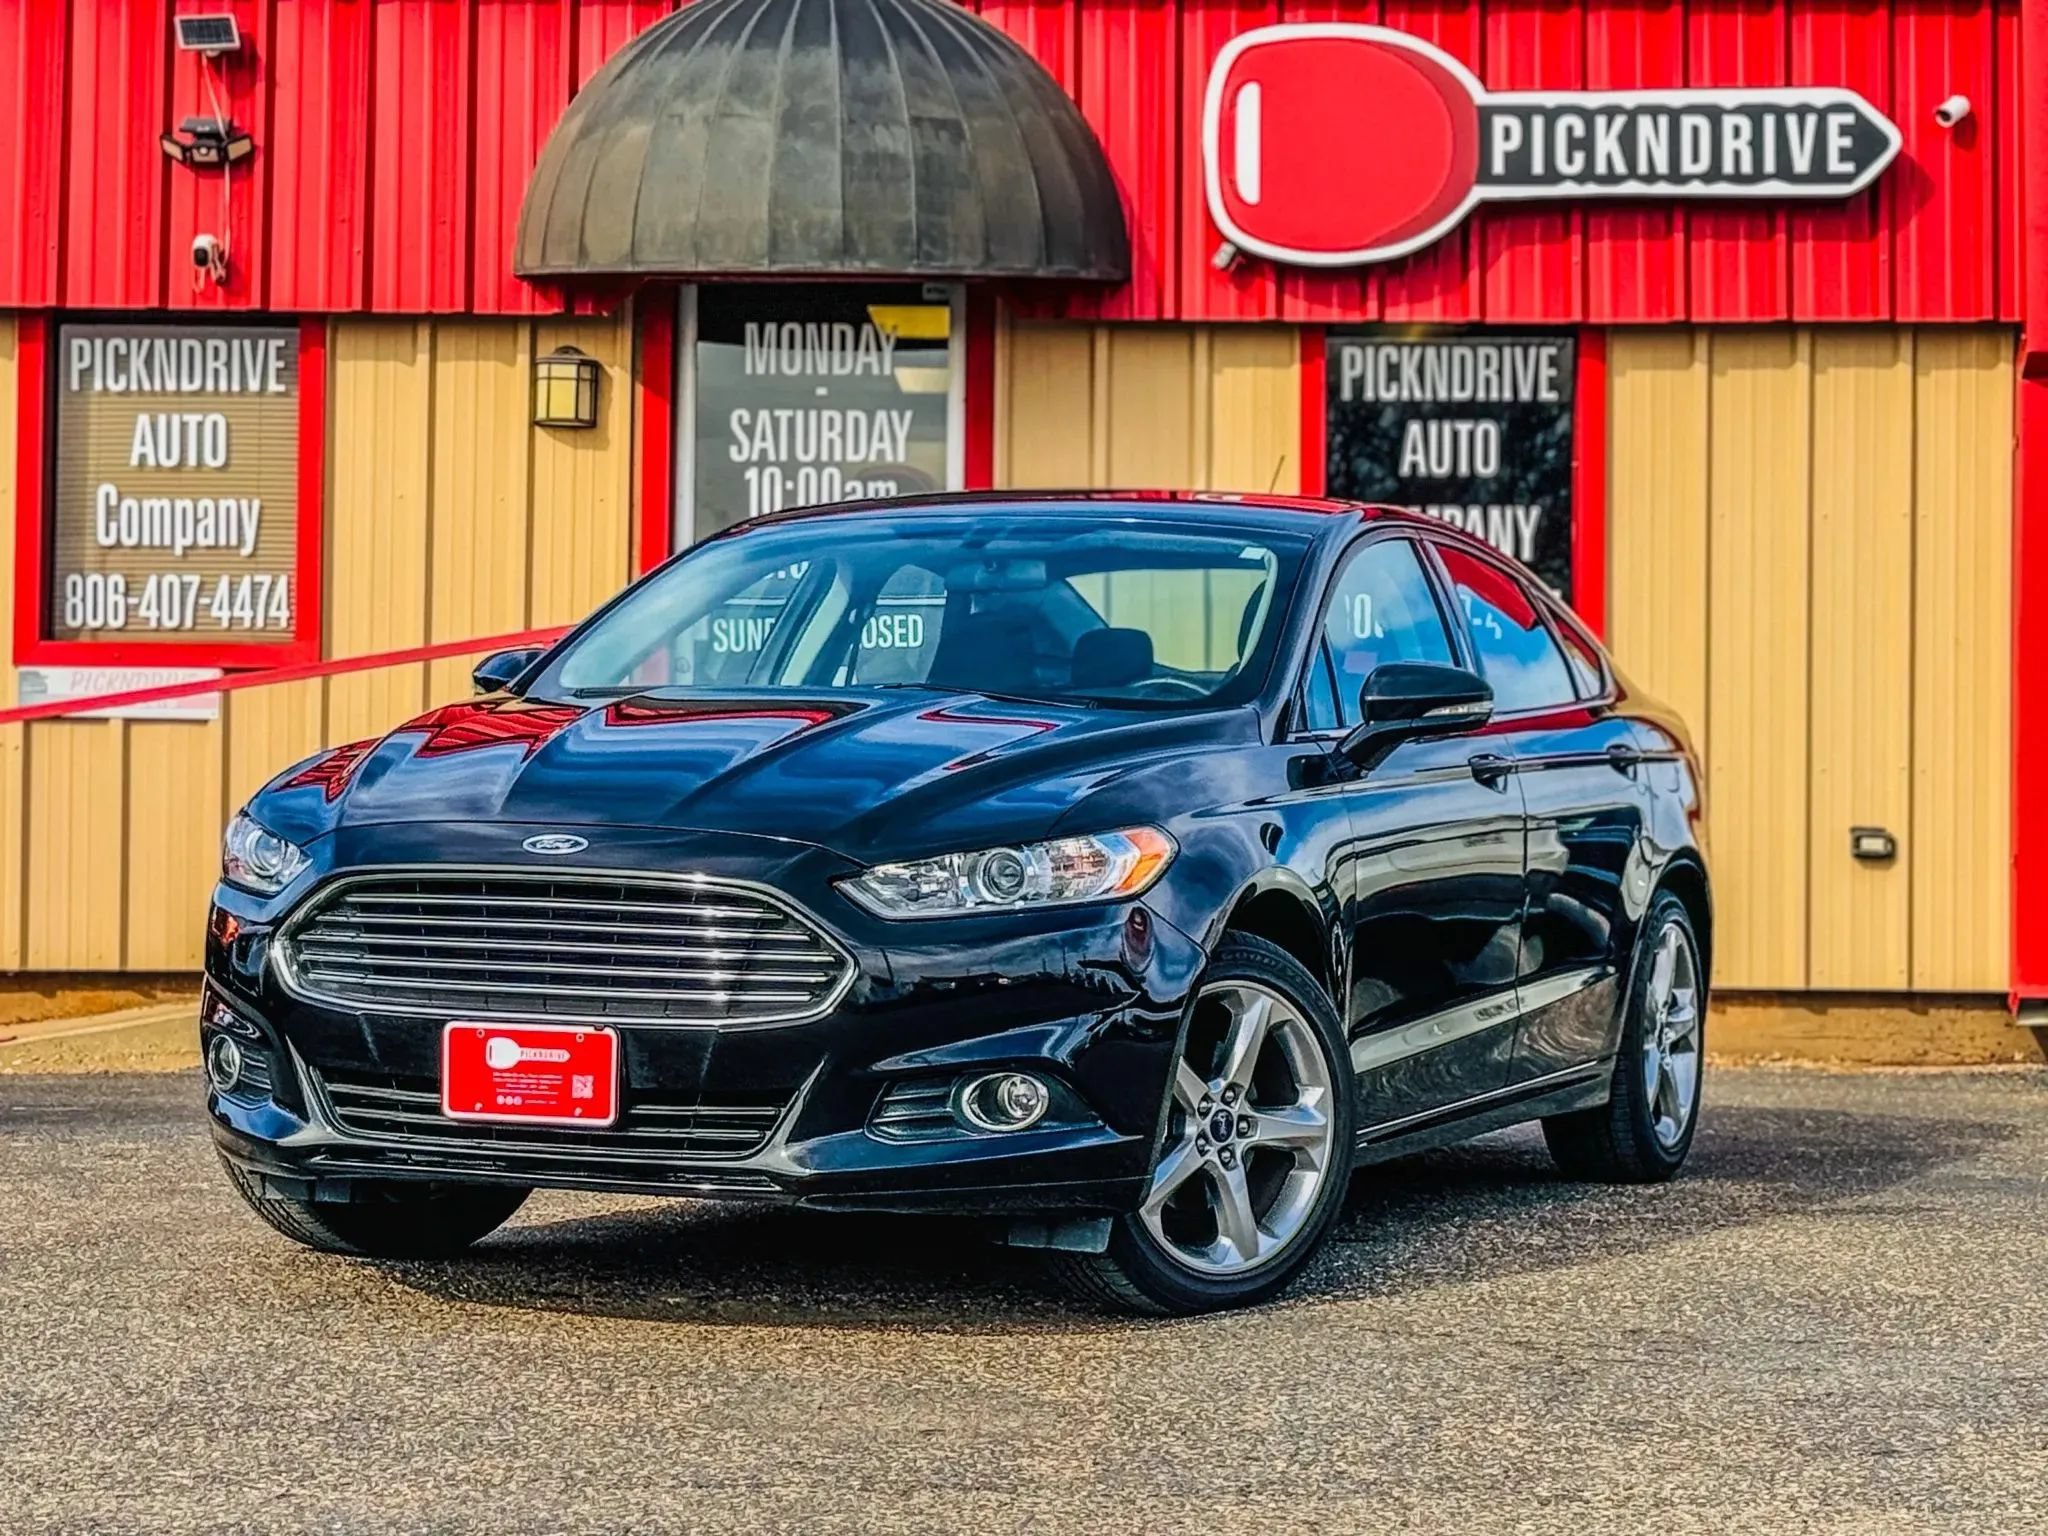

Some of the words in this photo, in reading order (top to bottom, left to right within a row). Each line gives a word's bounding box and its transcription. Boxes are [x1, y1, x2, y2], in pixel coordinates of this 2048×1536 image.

[1491, 112, 1856, 177] PICKNDRIVE
[70, 338, 287, 394] PICKNDRIVE
[744, 322, 898, 376] MONDAY
[1340, 345, 1559, 402] PICKNDRIVE
[129, 413, 228, 468] AUTO
[729, 409, 913, 463] SATURDAY
[1398, 419, 1499, 478] AUTO
[96, 483, 260, 557] Company
[65, 573, 290, 629] 806-407-4474
[861, 614, 924, 649] OSED
